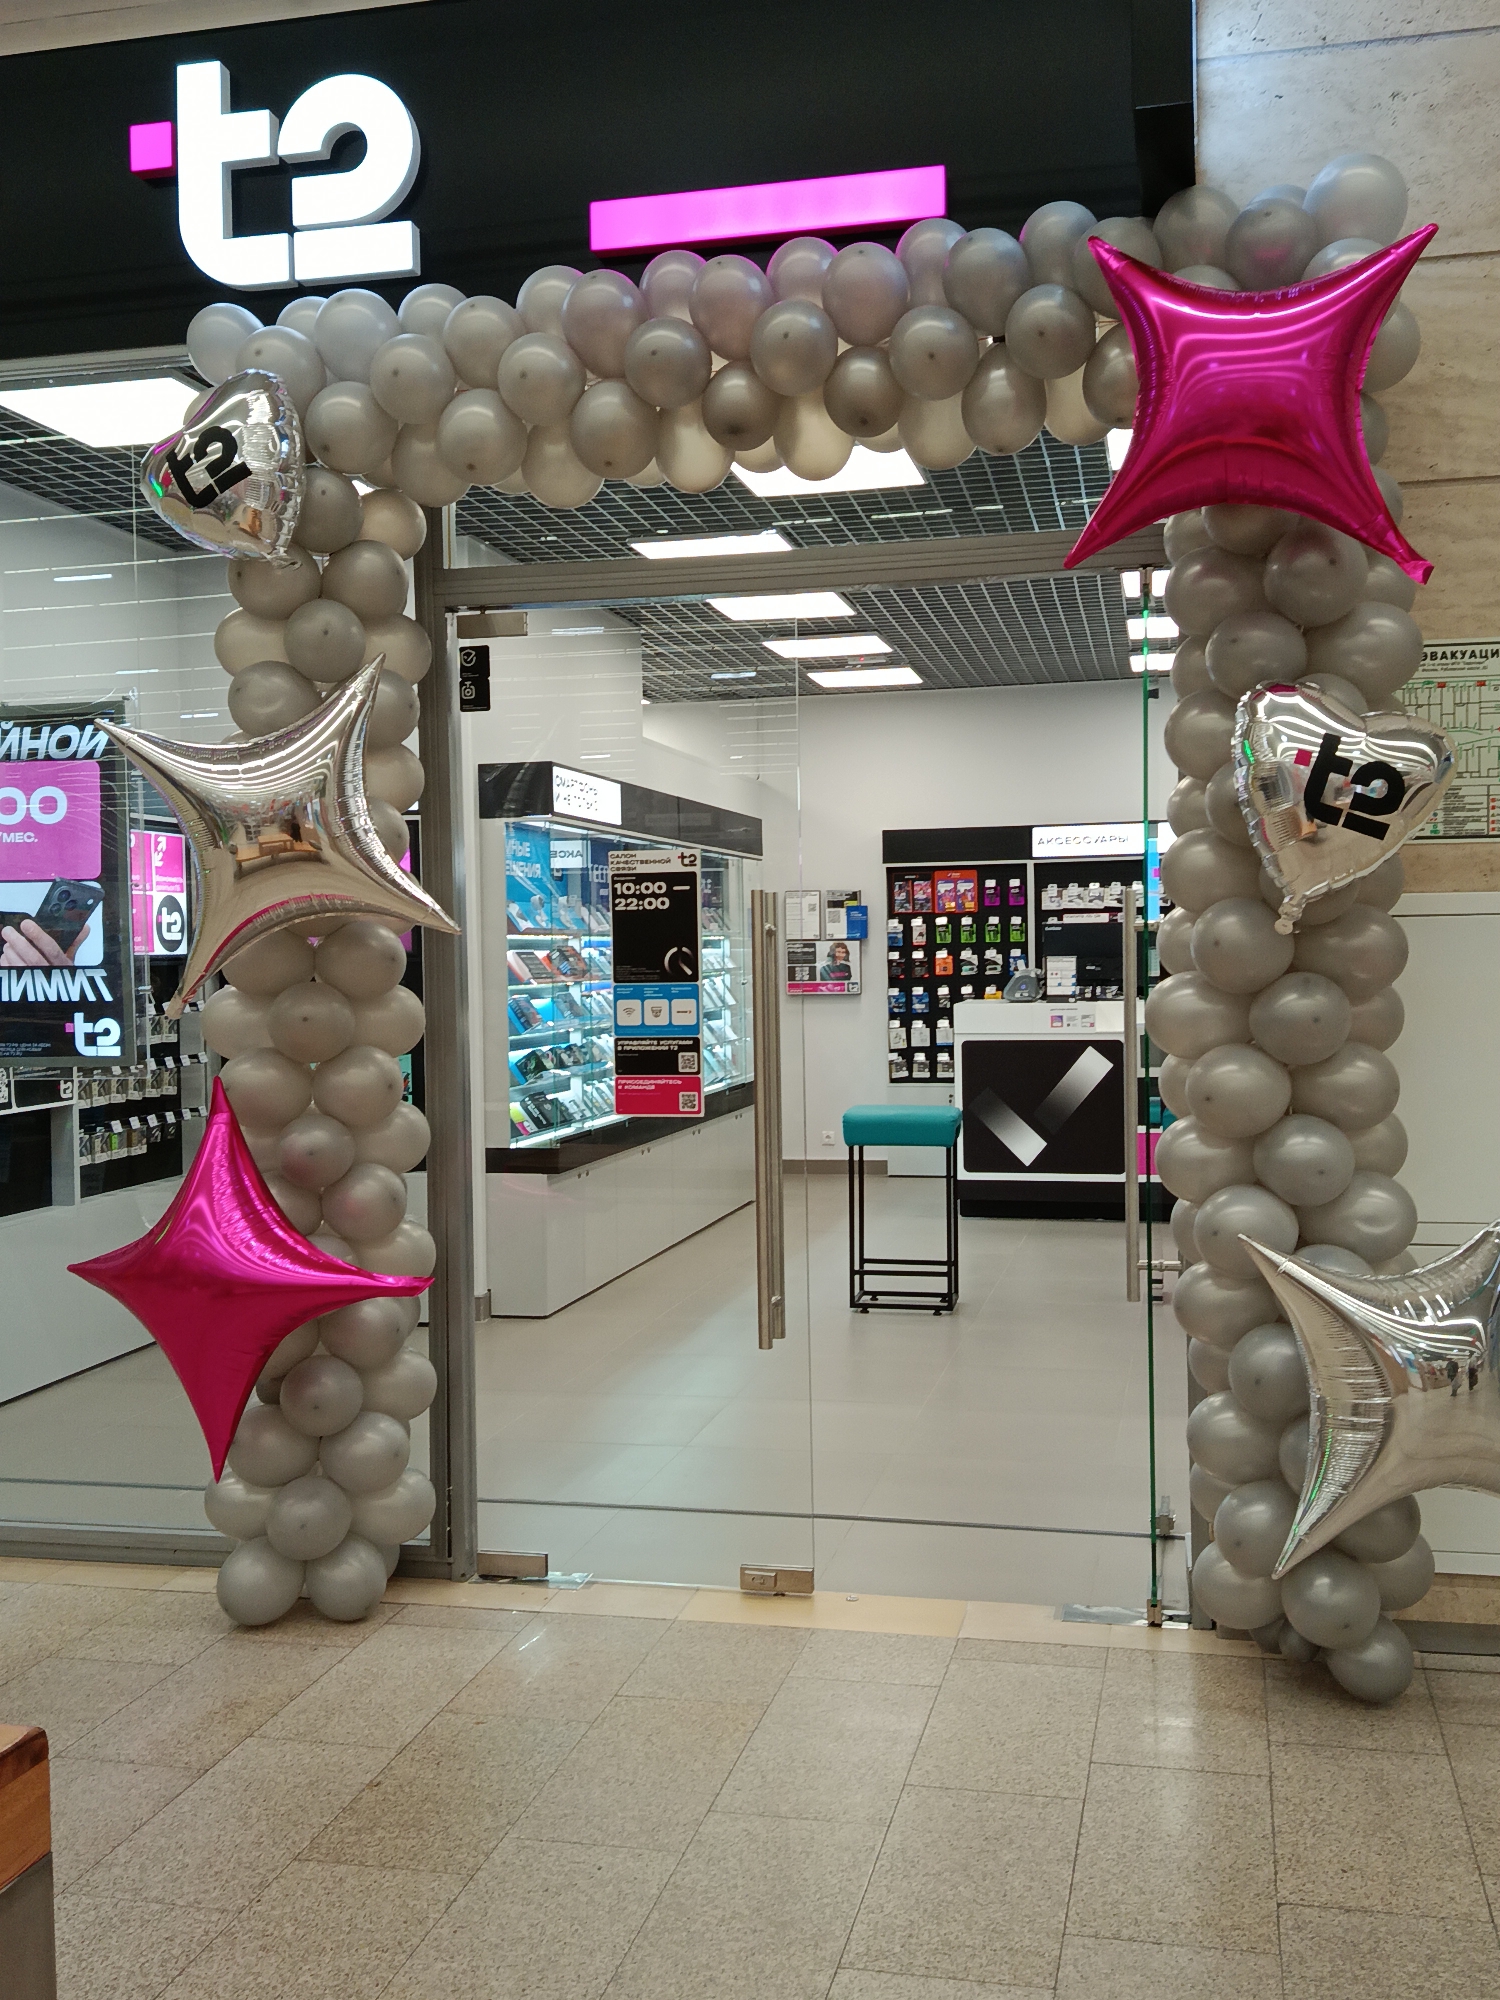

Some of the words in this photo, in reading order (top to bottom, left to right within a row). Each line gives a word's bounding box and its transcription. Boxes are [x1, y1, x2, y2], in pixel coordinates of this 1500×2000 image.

[130, 60, 421, 292] t2
[162, 425, 253, 509] t2
[1294, 732, 1406, 841] t2
[677, 851, 698, 868] t2
[613, 881, 667, 895] 10:00
[614, 897, 670, 911] 22:00
[158, 906, 182, 941] t2
[64, 1011, 122, 1057] t2
